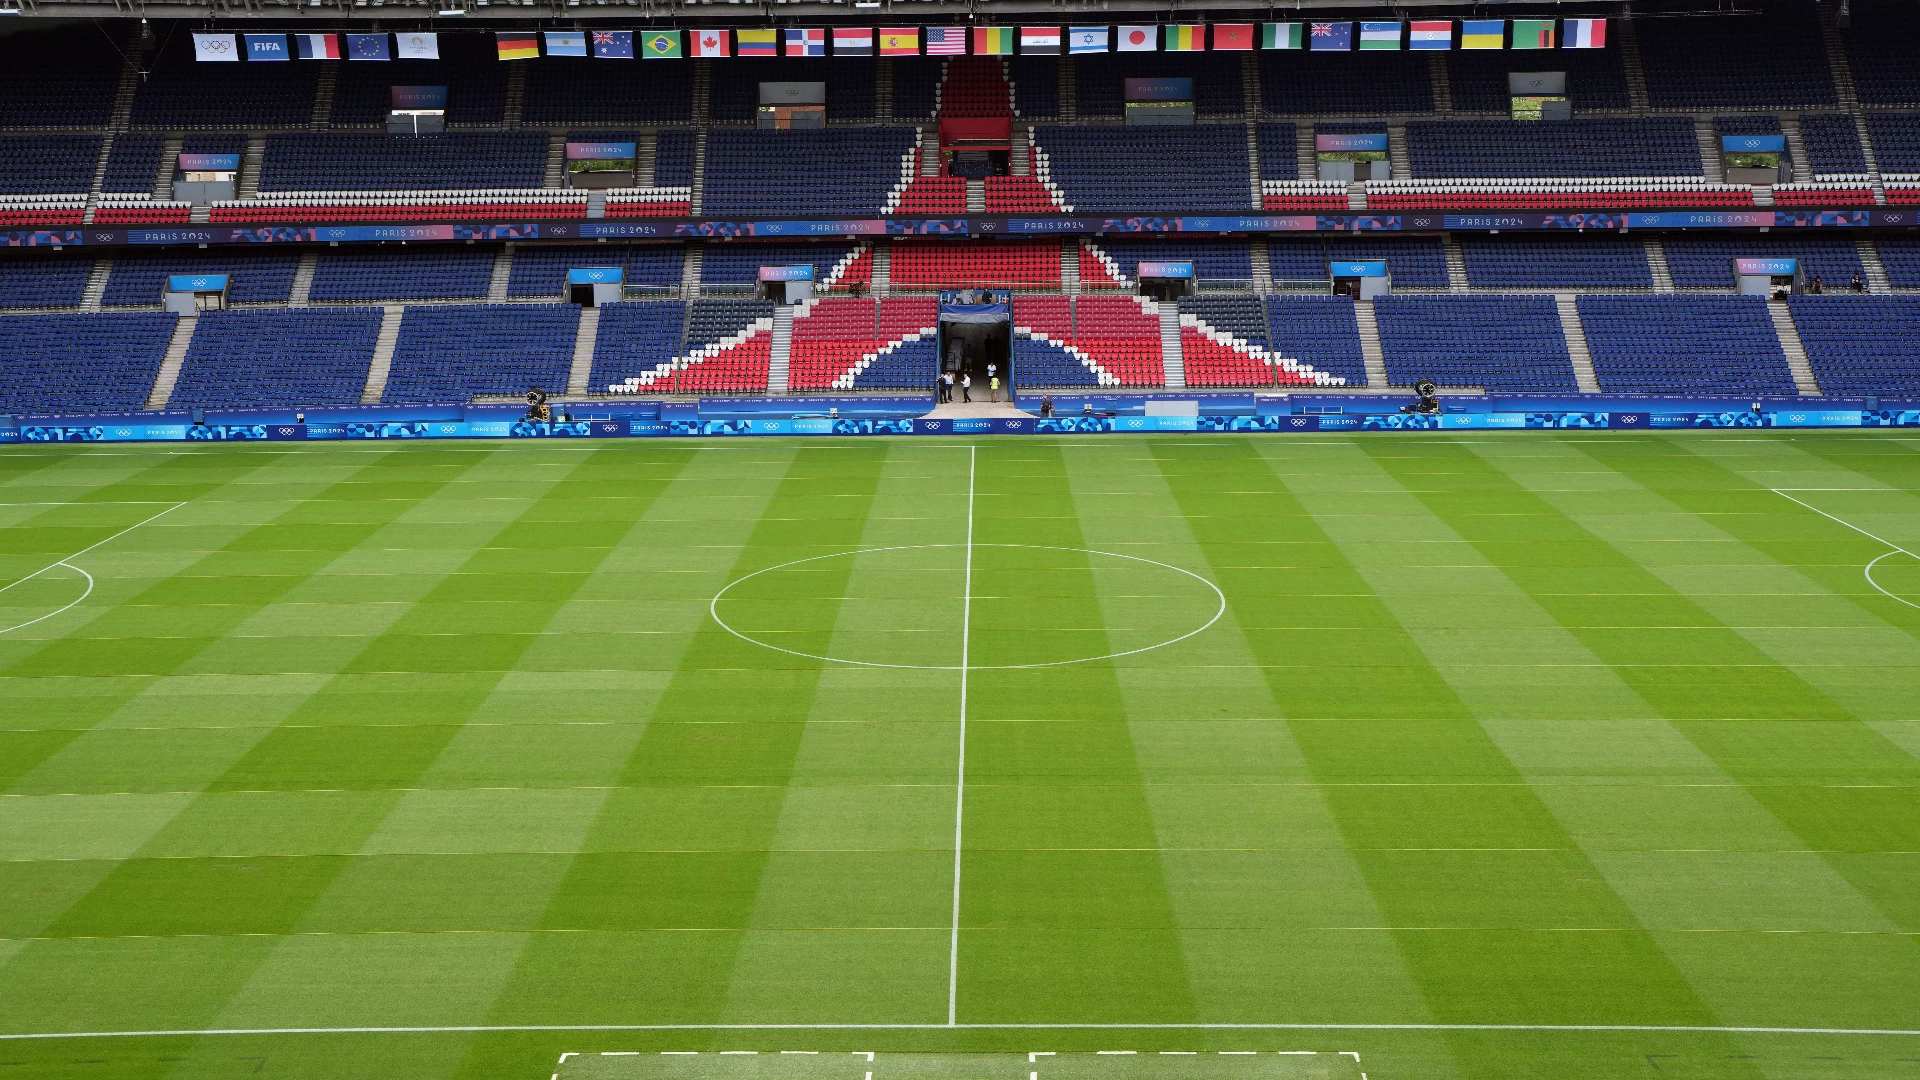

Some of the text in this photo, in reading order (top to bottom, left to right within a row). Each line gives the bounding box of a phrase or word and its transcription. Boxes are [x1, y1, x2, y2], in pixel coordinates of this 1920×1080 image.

[254, 42, 281, 51] FIFA
[146, 232, 211, 240] PARIS 2024
